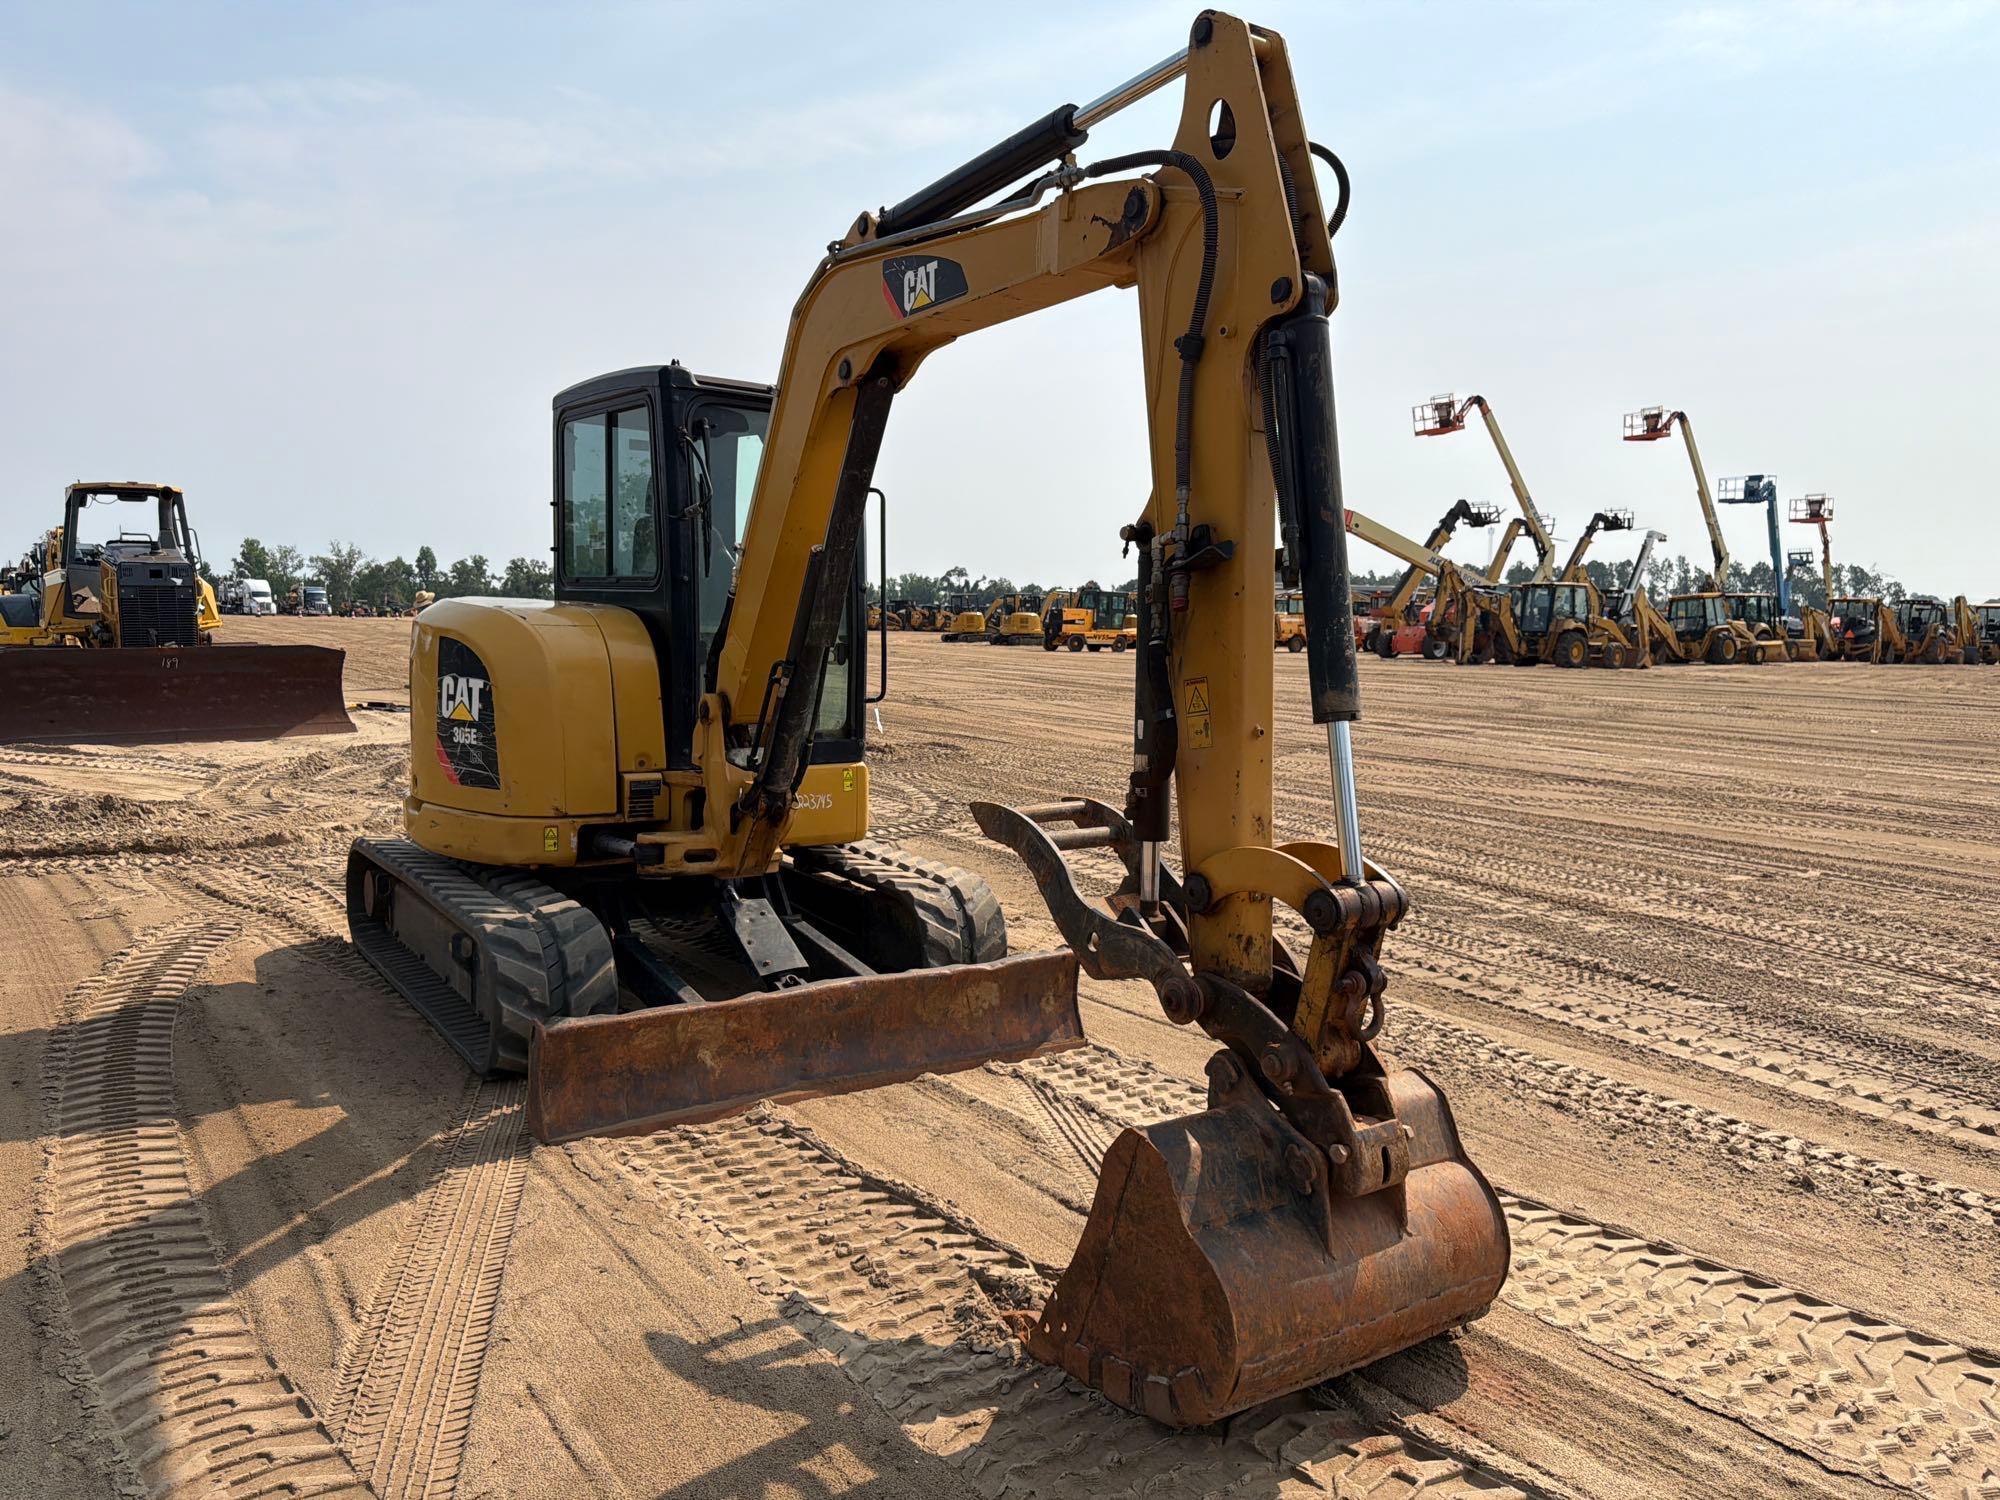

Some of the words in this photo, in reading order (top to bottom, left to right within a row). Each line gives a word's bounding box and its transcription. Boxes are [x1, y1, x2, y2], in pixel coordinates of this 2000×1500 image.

[903, 259, 938, 312] CAT
[441, 675, 484, 722] CAT
[453, 726, 477, 745] 305E
